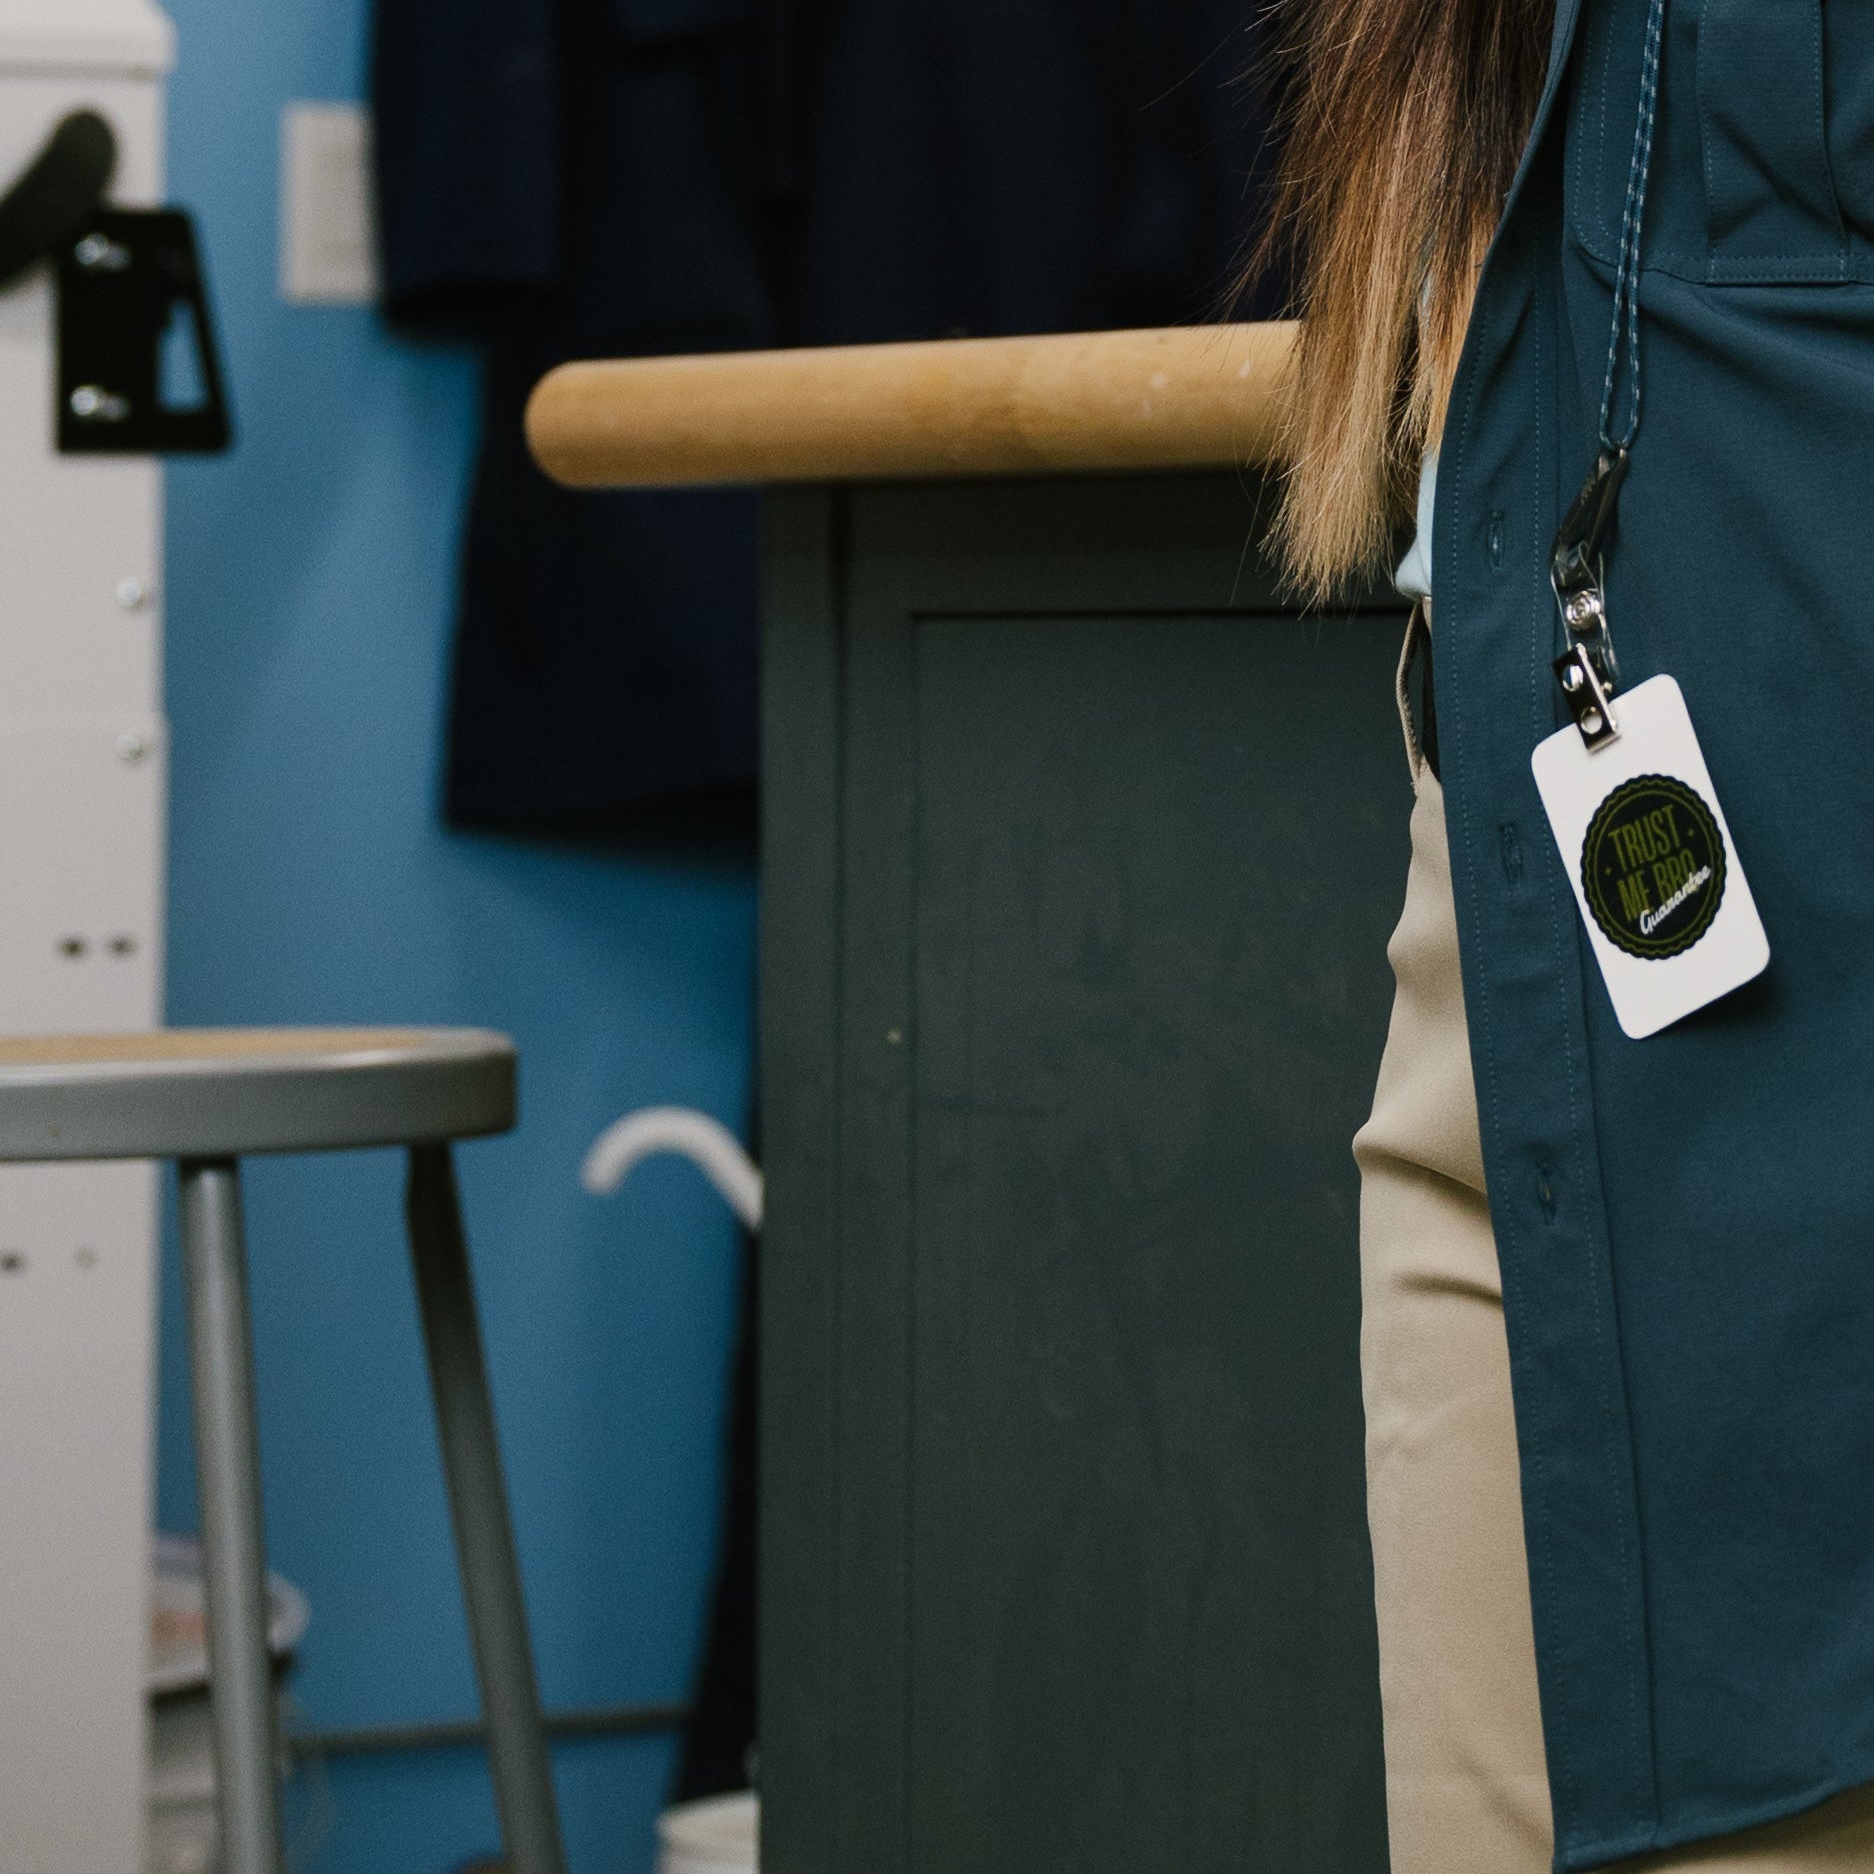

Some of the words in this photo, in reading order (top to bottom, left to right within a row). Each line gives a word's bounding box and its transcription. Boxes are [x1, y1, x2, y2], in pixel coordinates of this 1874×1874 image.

[1608, 803, 1681, 873] TRUST
[1617, 869, 1655, 923] ME
[1652, 848, 1699, 904] BRO
[1639, 864, 1712, 936] Guarantee
